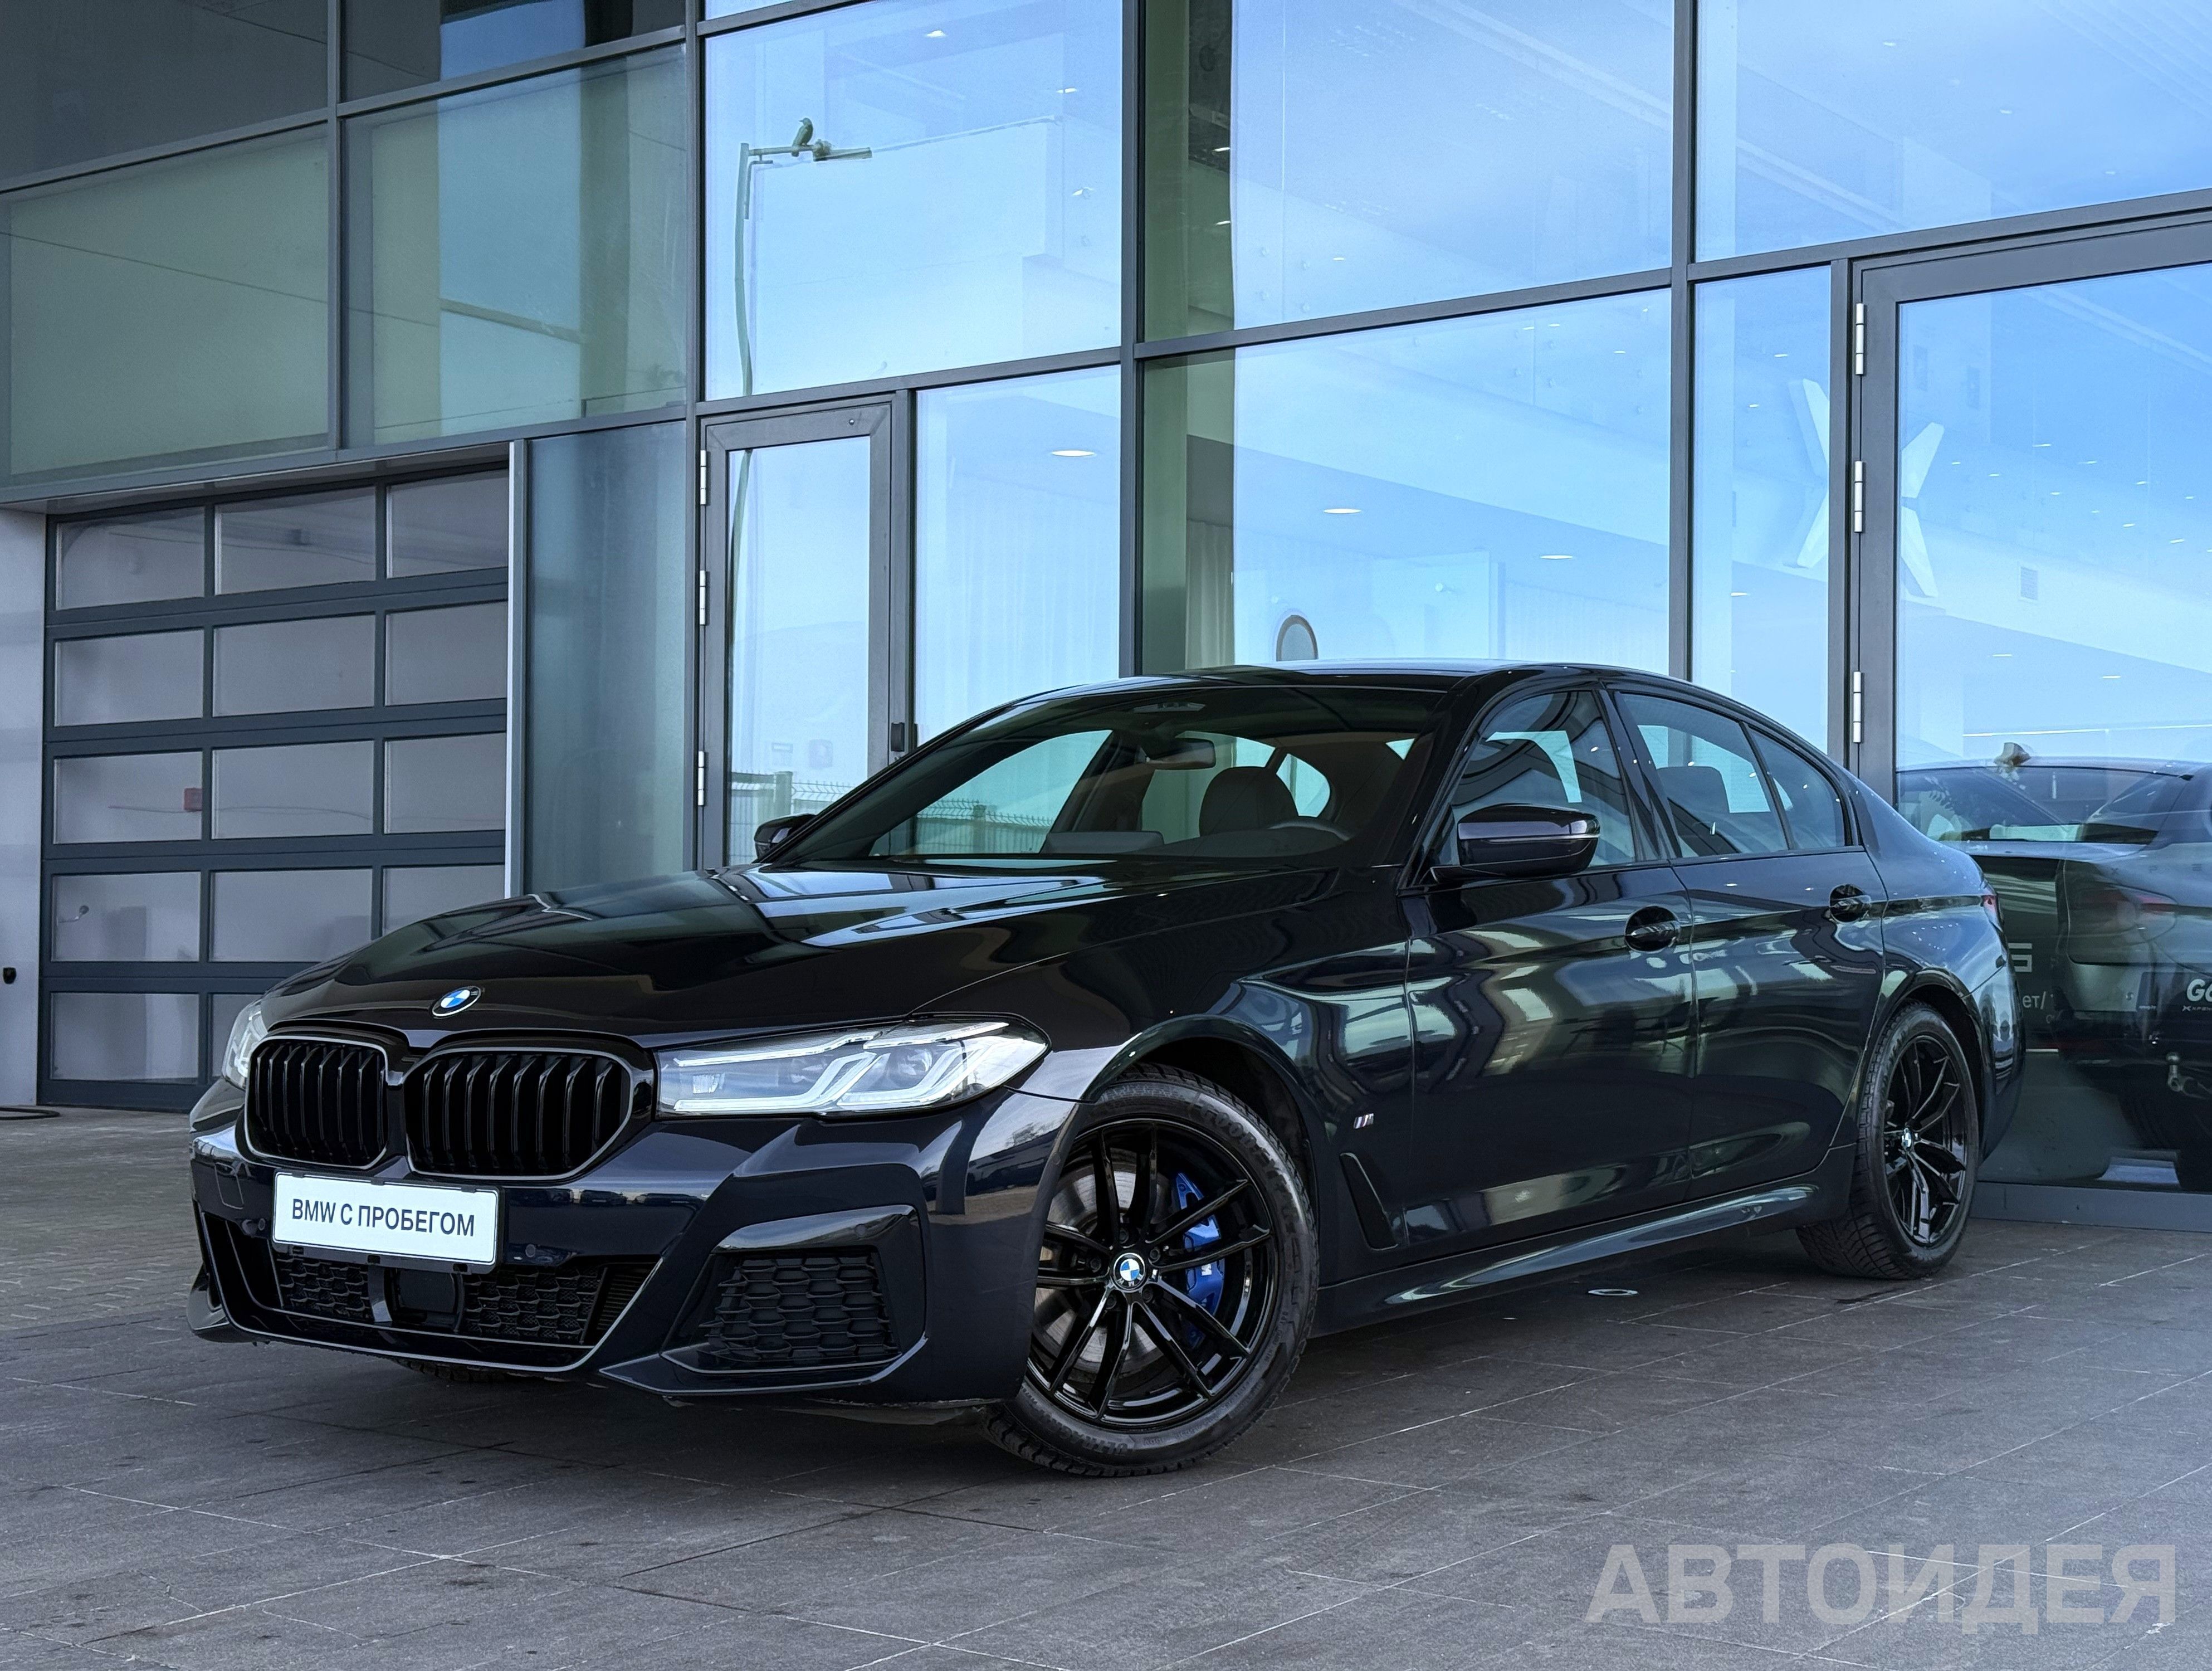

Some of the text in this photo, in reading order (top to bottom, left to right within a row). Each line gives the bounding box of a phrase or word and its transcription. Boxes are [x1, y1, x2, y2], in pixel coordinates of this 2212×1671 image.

[292, 1199, 475, 1236] BMW С ПРОБЕГОМ
